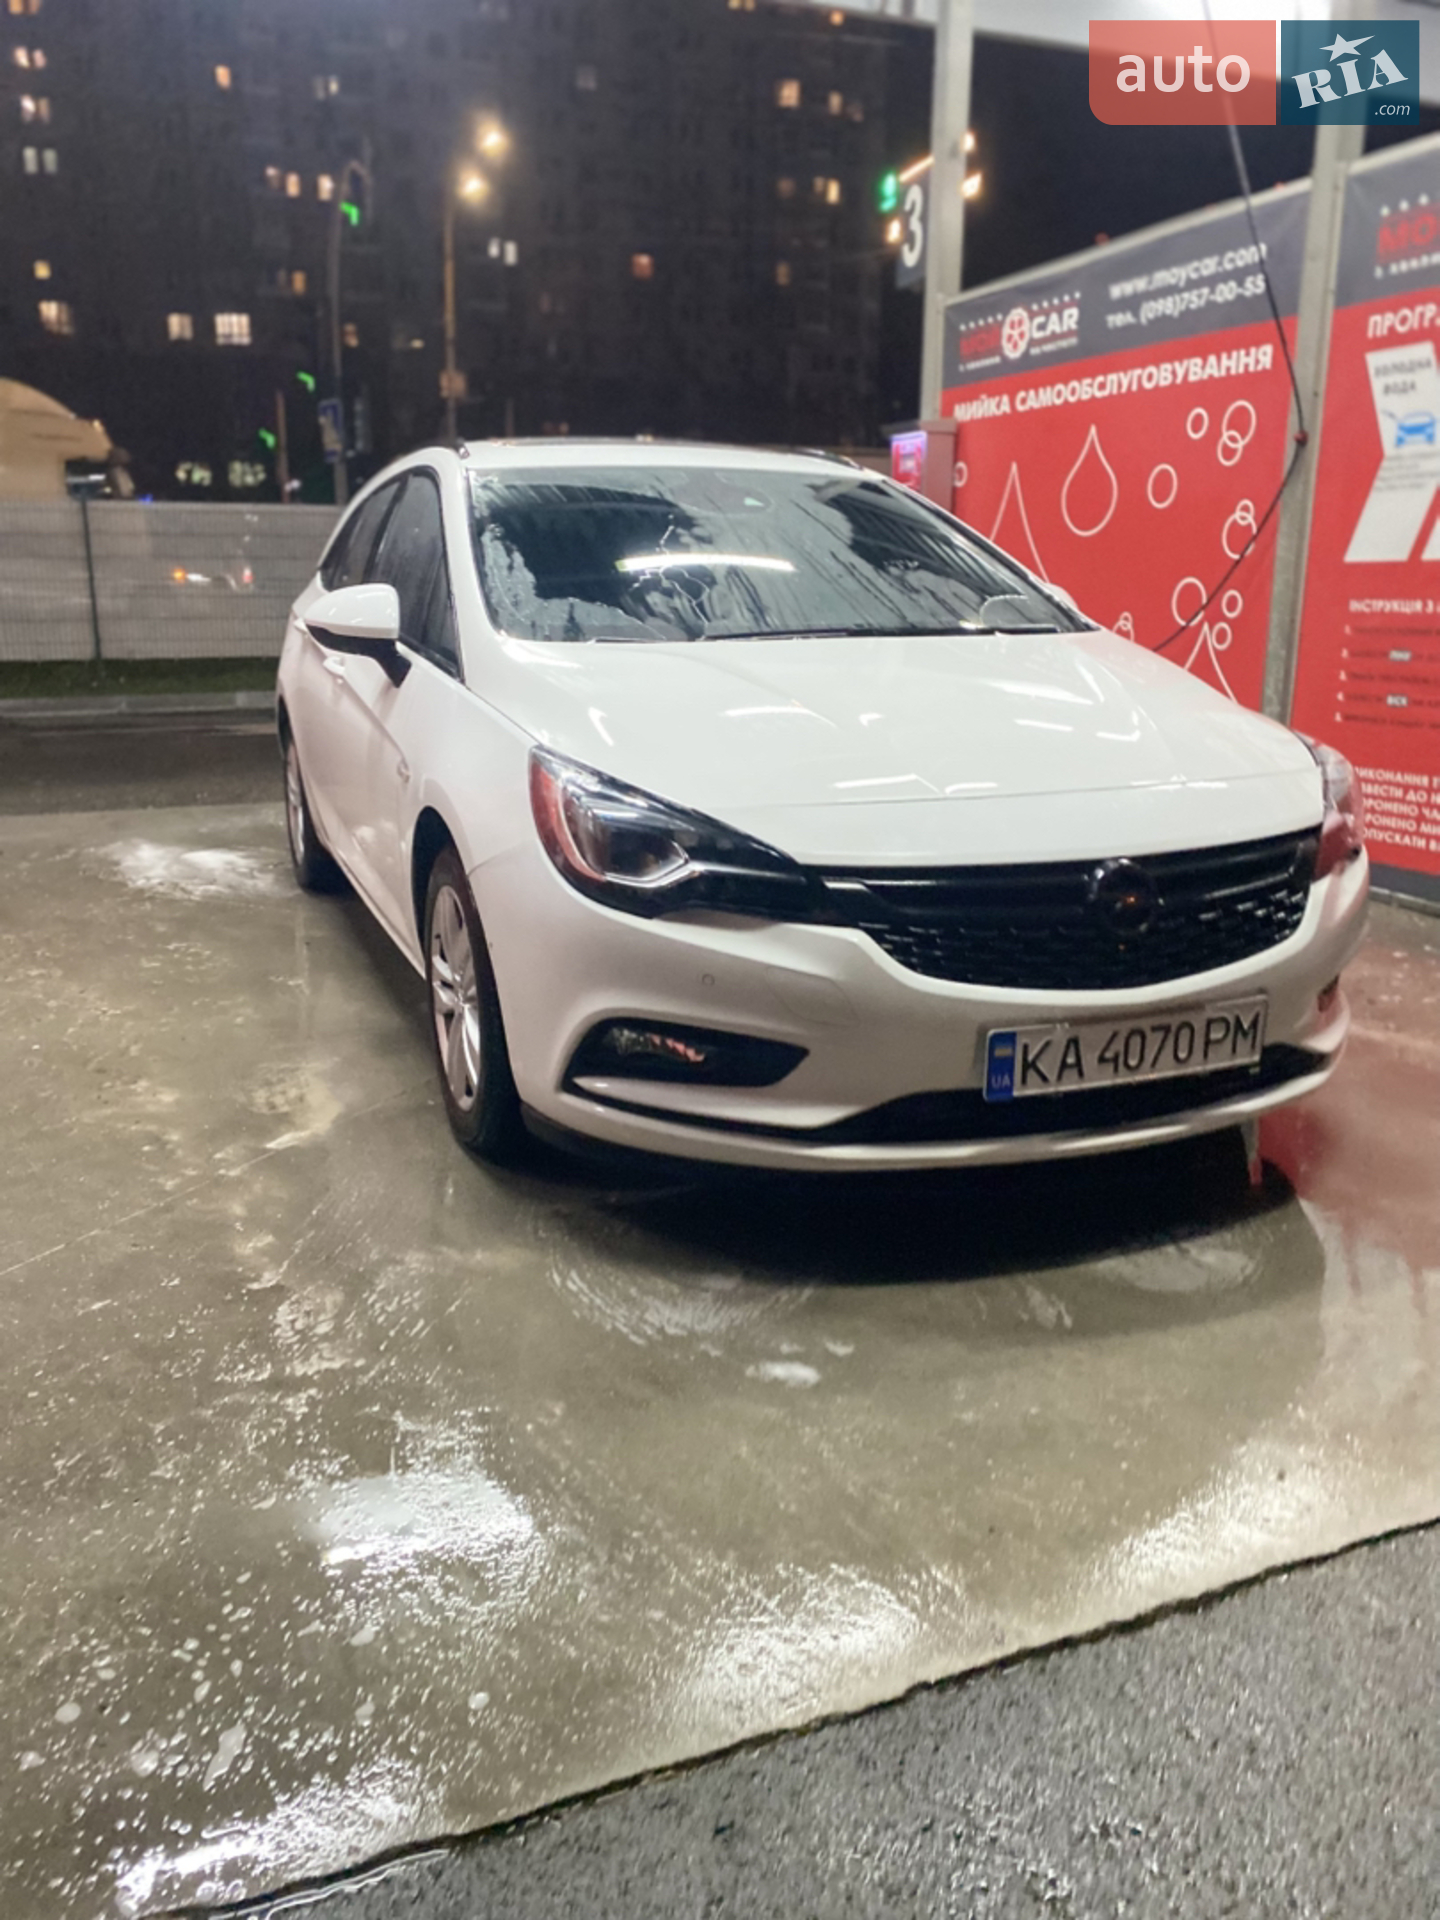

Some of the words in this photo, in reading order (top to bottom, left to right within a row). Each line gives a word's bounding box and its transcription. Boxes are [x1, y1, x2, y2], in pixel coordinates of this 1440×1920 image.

[901, 183, 924, 268] 3
[1109, 243, 1267, 300] www.moycar.com
[1140, 273, 1265, 325] (098)757-00-55
[1367, 303, 1440, 339] ПРОГР
[1032, 307, 1079, 339] CAR
[954, 394, 1011, 422] МИЙКА
[1015, 344, 1274, 413] САМООБСЛУГОВУВАННЯ
[1406, 789, 1428, 803] ДО
[1365, 813, 1417, 832] РОНЕНО
[1020, 1036, 1085, 1086] KA
[1097, 1020, 1196, 1074] 4070
[1203, 1011, 1261, 1061] PM
[991, 1074, 1011, 1089] UA
